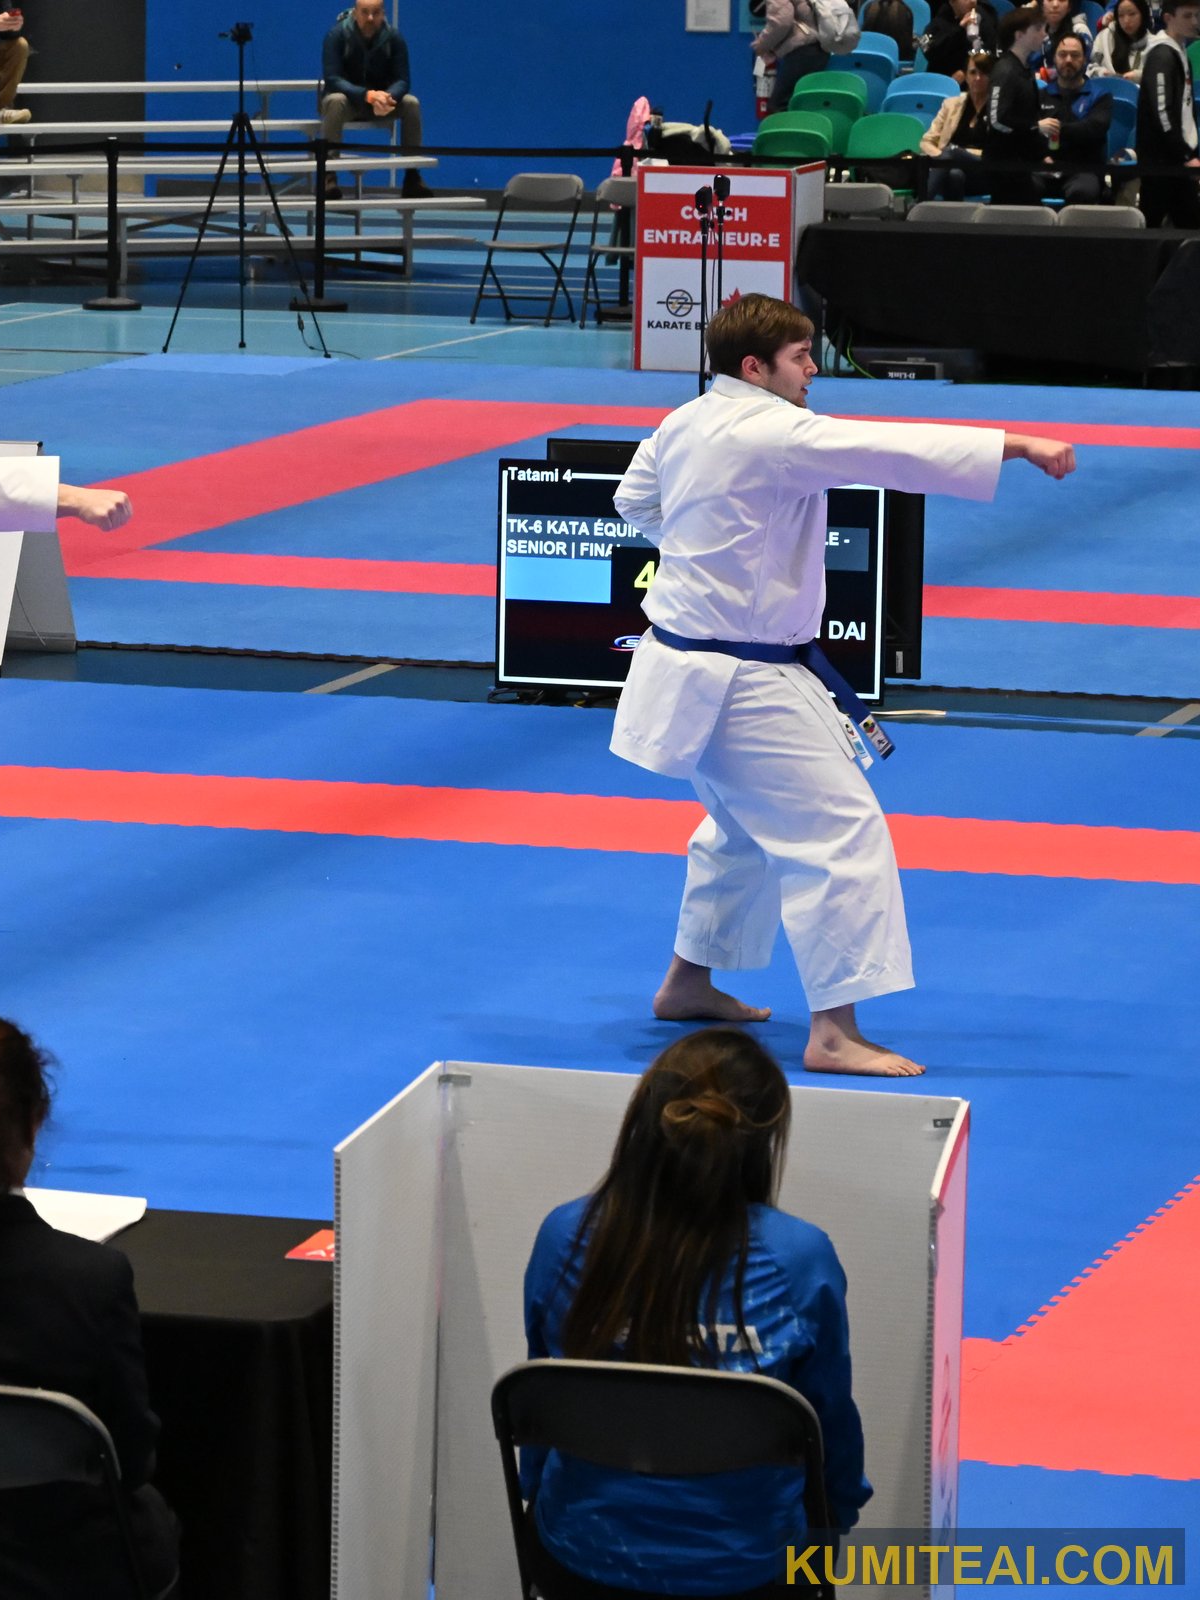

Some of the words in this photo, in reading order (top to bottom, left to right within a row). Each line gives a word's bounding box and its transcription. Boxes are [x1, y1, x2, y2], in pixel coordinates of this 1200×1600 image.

[647, 320, 692, 330] KARATE
[508, 467, 559, 482] Tatami
[562, 469, 573, 483] 4
[507, 518, 543, 534] TK-6
[546, 520, 590, 536] KATA
[593, 518, 646, 538] ÉQUIP
[824, 531, 840, 546] E
[506, 539, 568, 555] SENIOR
[579, 543, 621, 558] FINA
[827, 620, 867, 641] DAI
